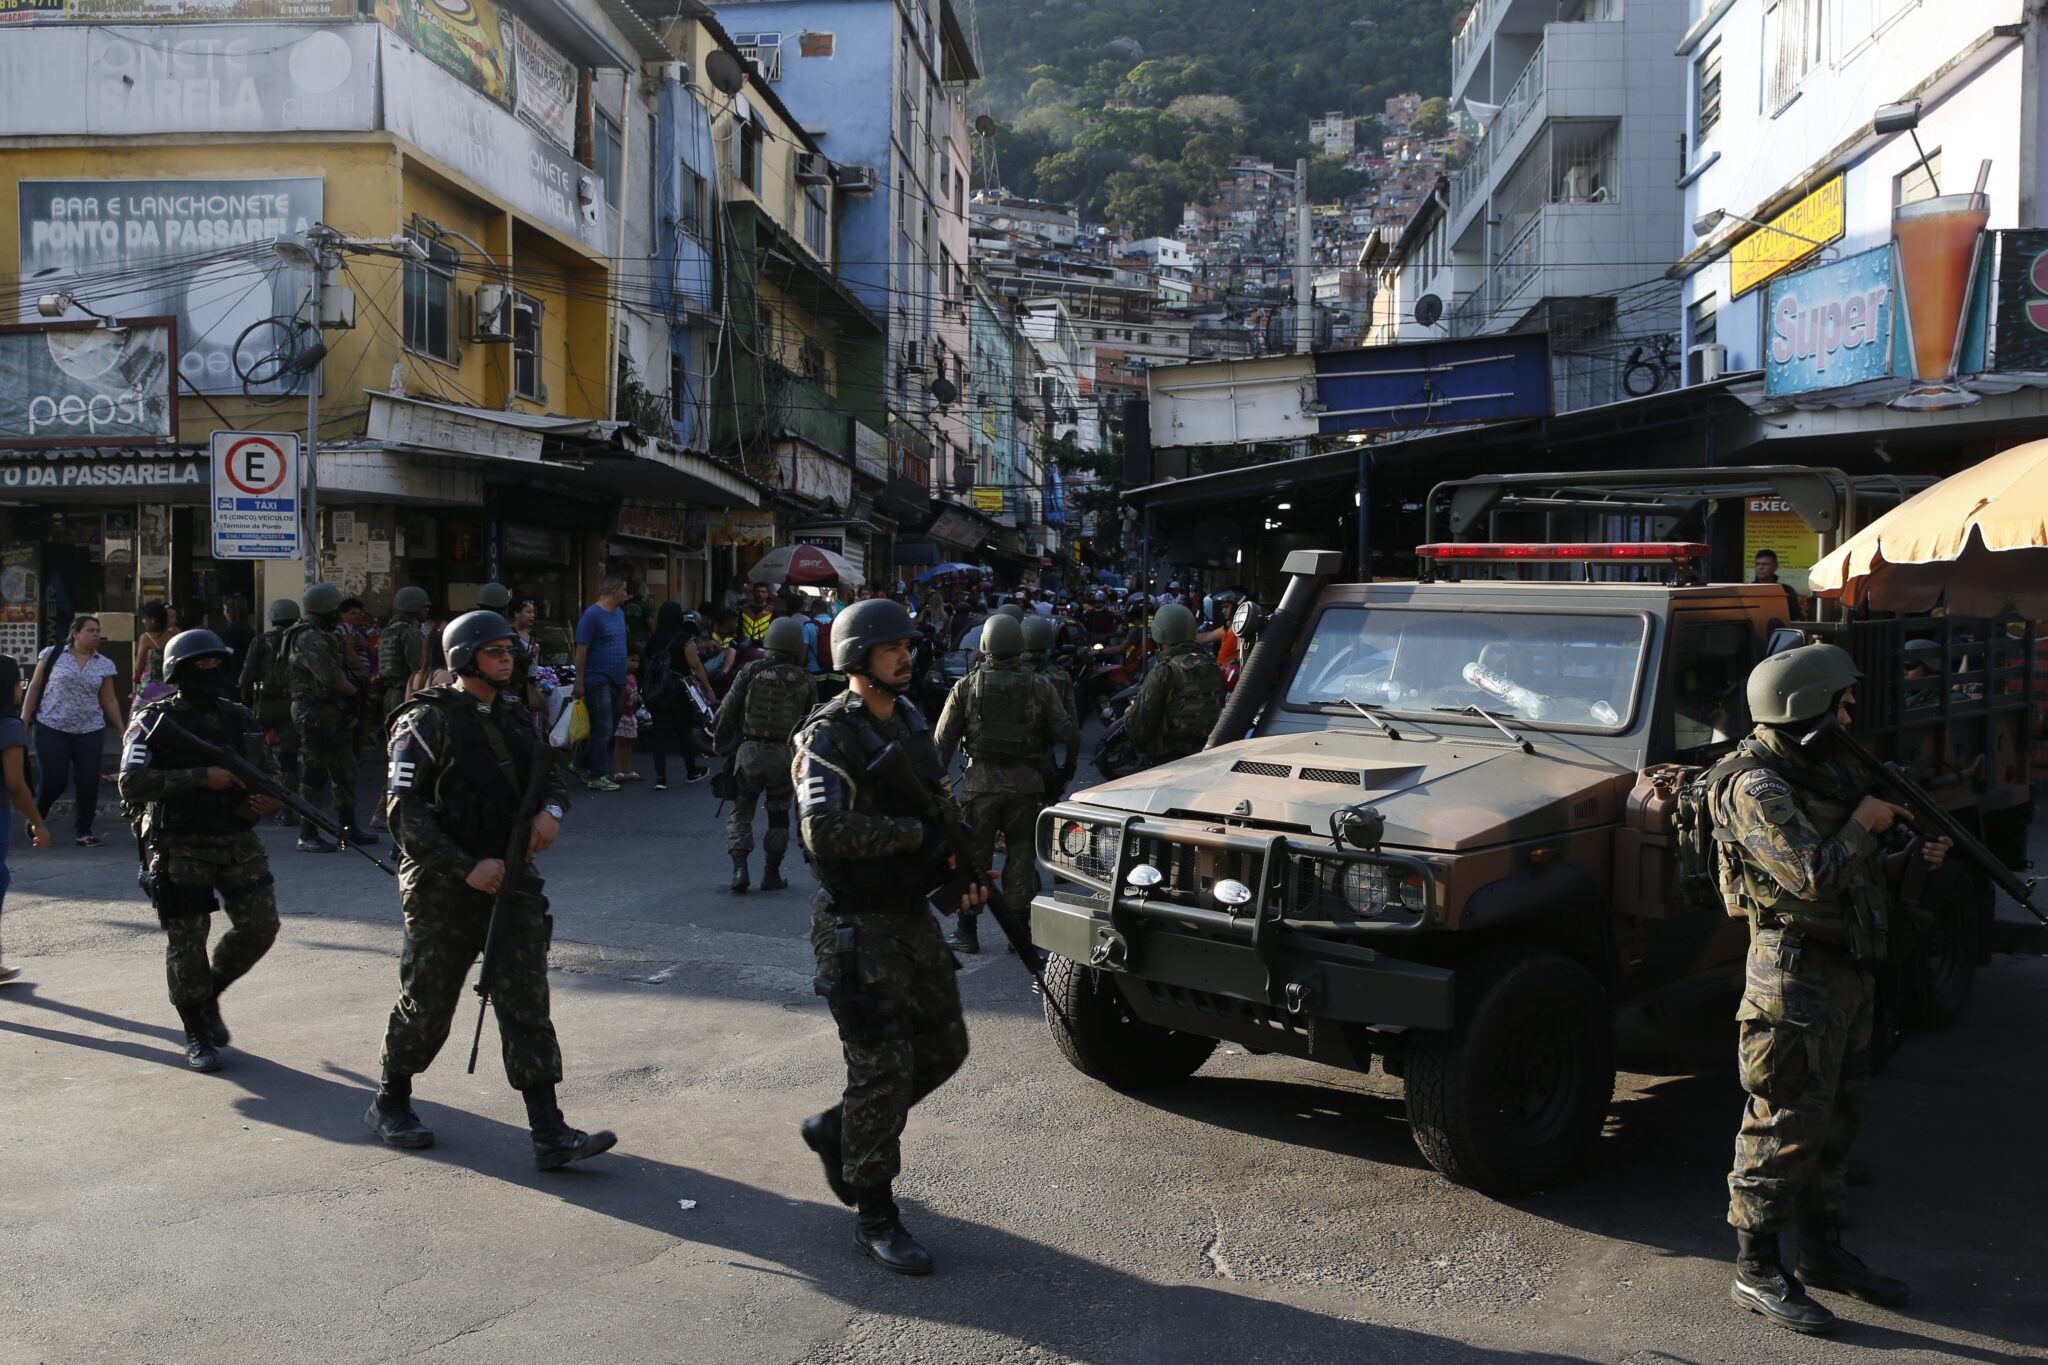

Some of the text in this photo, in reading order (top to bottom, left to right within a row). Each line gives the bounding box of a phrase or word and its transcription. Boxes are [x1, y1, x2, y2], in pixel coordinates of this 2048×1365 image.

[51, 194, 289, 217] BAR E LANCHONETE
[32, 220, 120, 250] PONTO
[125, 220, 160, 247] DA
[1774, 287, 1886, 371] Super
[28, 386, 146, 434] pepsi
[26, 466, 61, 486] DA
[62, 462, 200, 485] PASSARELA
[246, 452, 266, 482] E
[254, 500, 278, 510] TÁXI
[799, 559, 824, 568] SKY
